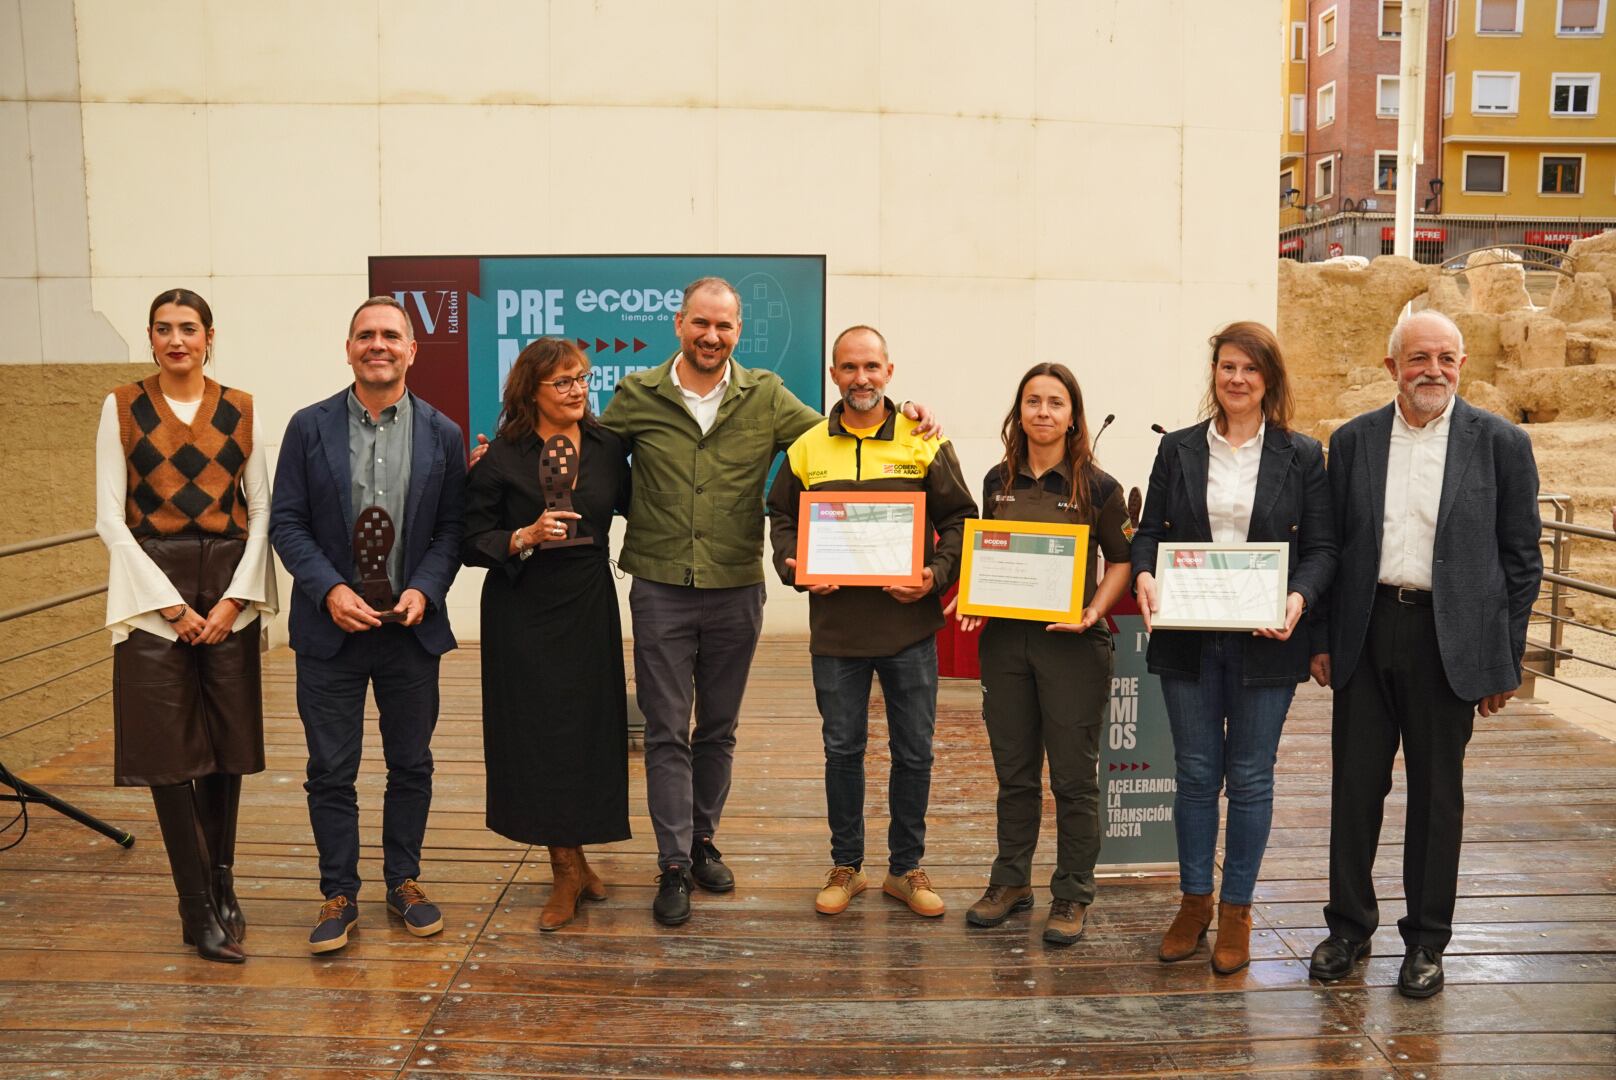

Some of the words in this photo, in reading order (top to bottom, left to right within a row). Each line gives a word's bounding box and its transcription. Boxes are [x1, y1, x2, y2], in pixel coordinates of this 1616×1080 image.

[448, 291, 459, 334] Edición
[497, 289, 564, 335] PRE
[621, 313, 654, 322] tiempo
[656, 313, 669, 321] de
[1111, 677, 1139, 696] PRE
[1110, 697, 1138, 723] MI
[1109, 723, 1137, 750] OS
[1107, 793, 1121, 808] LA
[1107, 804, 1173, 823] TRANSICIÓN
[1105, 822, 1142, 838] JUSTA
